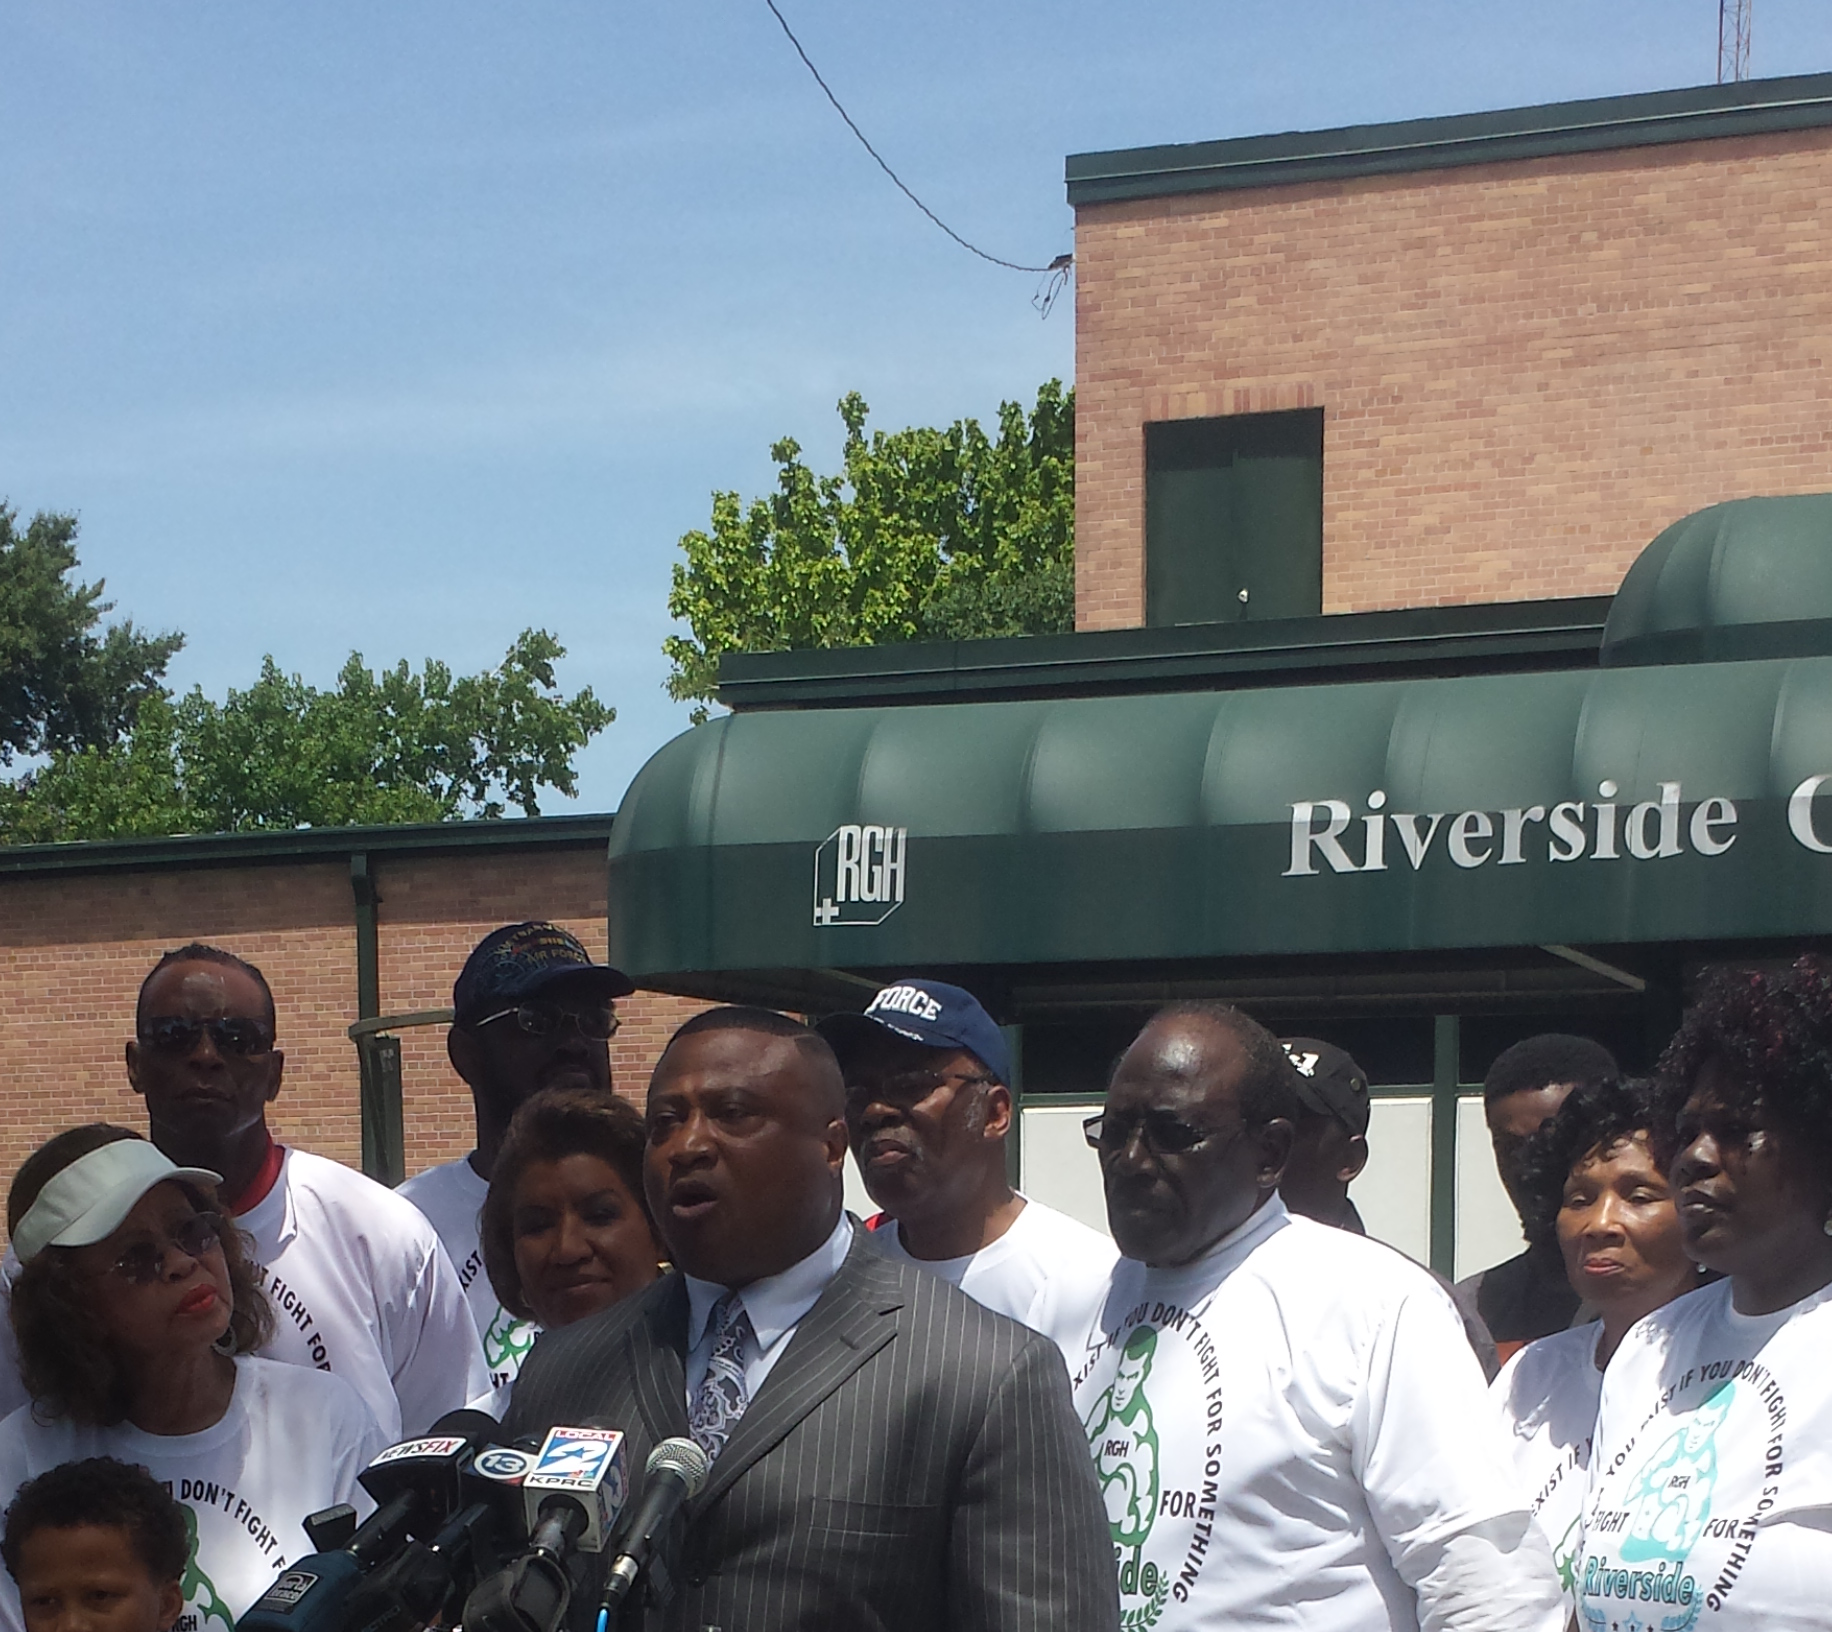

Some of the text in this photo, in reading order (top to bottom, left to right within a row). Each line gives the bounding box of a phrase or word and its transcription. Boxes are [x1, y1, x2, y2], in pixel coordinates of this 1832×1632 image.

[1280, 780, 1739, 877] Riverside
[836, 825, 906, 903] RGH
[863, 985, 943, 1021] FORCE
[270, 1276, 313, 1332] FIGHT
[1073, 1342, 1102, 1392] XIST
[1193, 1331, 1220, 1385] FIGHT
[1679, 1368, 1695, 1392] IF
[1700, 1360, 1733, 1382] YOU
[1205, 1387, 1223, 1437] FOR
[1760, 1380, 1786, 1432] FIGHT
[556, 1430, 616, 1441] LOCAL
[1104, 1440, 1129, 1458] RGH
[1765, 1433, 1783, 1478] FOR
[485, 1454, 524, 1473] 13
[530, 1476, 594, 1488] KPRC
[181, 1479, 235, 1512] DON'T
[234, 1499, 278, 1555] FIGHT
[1159, 1490, 1197, 1519] FOR
[1172, 1443, 1223, 1603] SOMETHING
[1703, 1518, 1740, 1539] FOR
[1706, 1485, 1779, 1612] SOMETHING
[1583, 1556, 1696, 1606] Riverside
